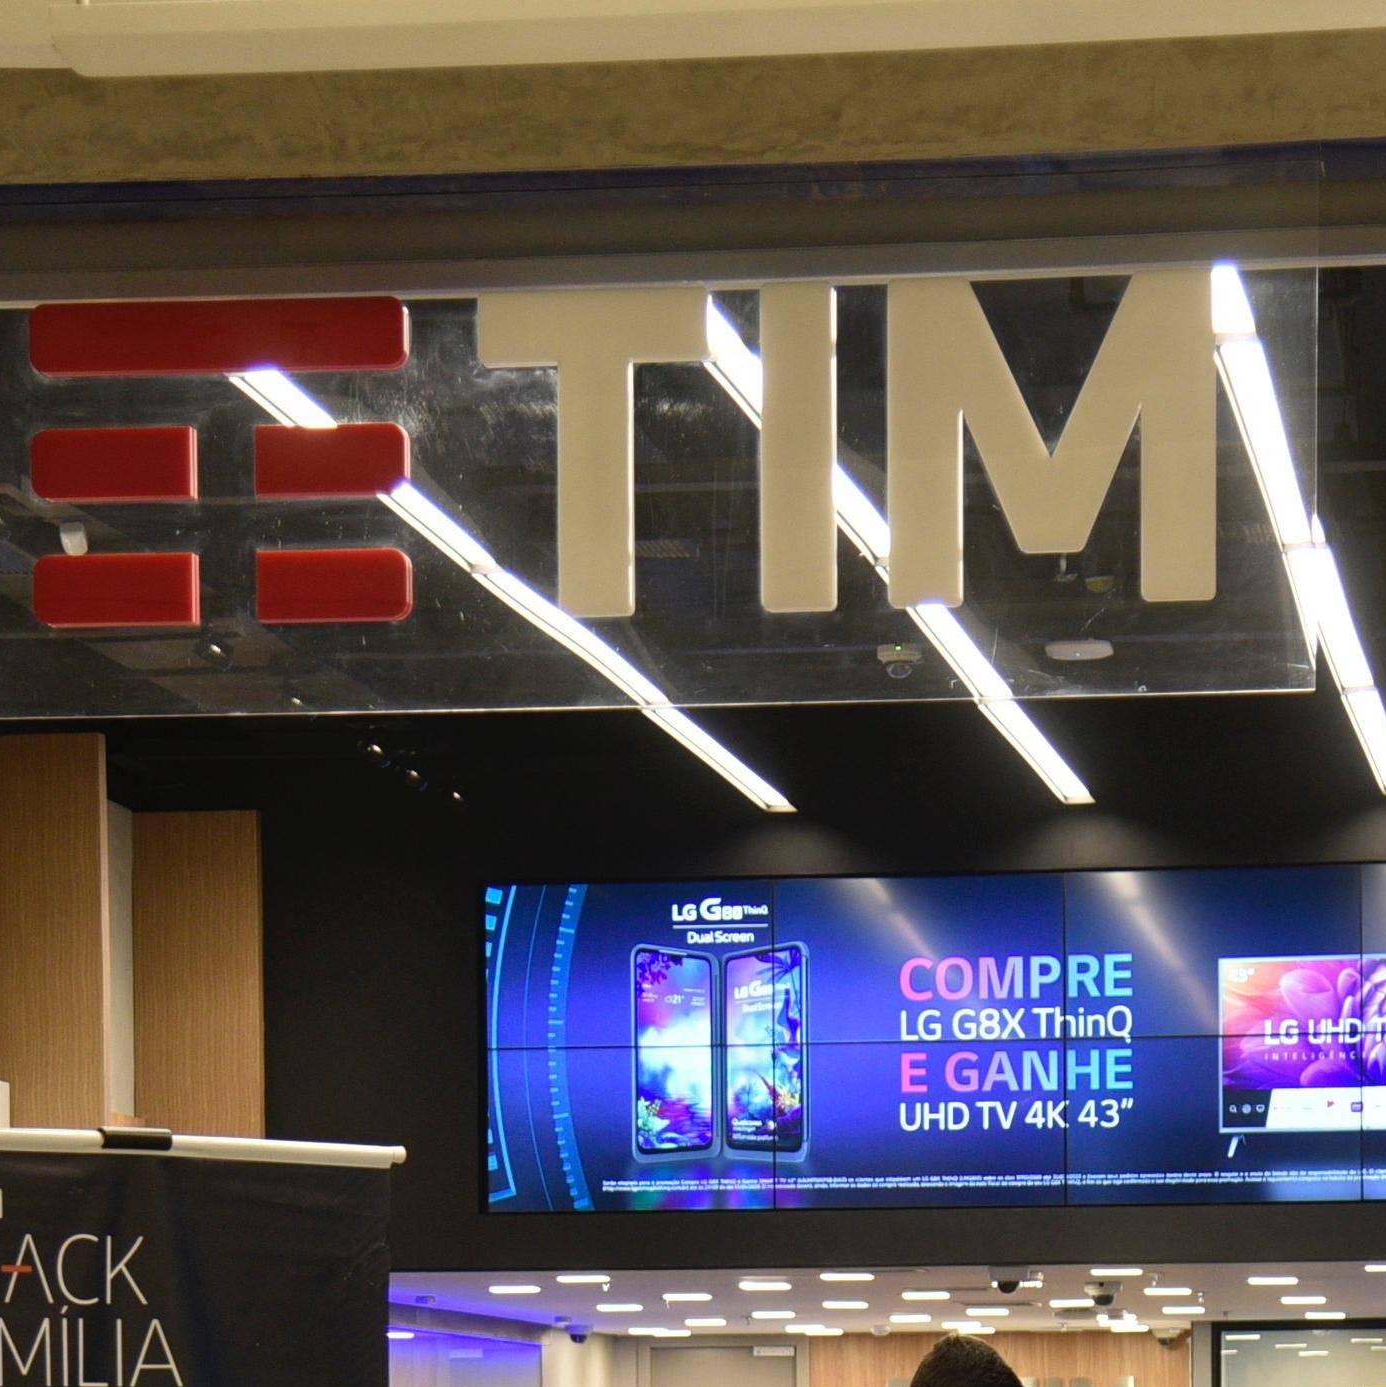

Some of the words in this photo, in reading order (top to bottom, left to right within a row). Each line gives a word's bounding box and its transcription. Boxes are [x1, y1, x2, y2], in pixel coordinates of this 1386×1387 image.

[477, 268, 1216, 618] TIM
[672, 904, 697, 921] LG
[687, 931, 714, 944] Dual
[714, 931, 754, 943] Screen
[734, 986, 748, 999] LG
[899, 953, 1133, 1003] COMPRE
[900, 1010, 941, 1042] LG
[952, 1007, 1025, 1041] G8X
[1032, 1004, 1132, 1043] ThinQ
[1264, 1020, 1299, 1046] LG
[1308, 1018, 1365, 1044] UHD
[901, 1052, 928, 1094] E
[945, 1048, 1133, 1093] GANHE
[900, 1100, 969, 1131] UHD
[975, 1100, 1019, 1130] TV
[1025, 1099, 1067, 1130] 4K
